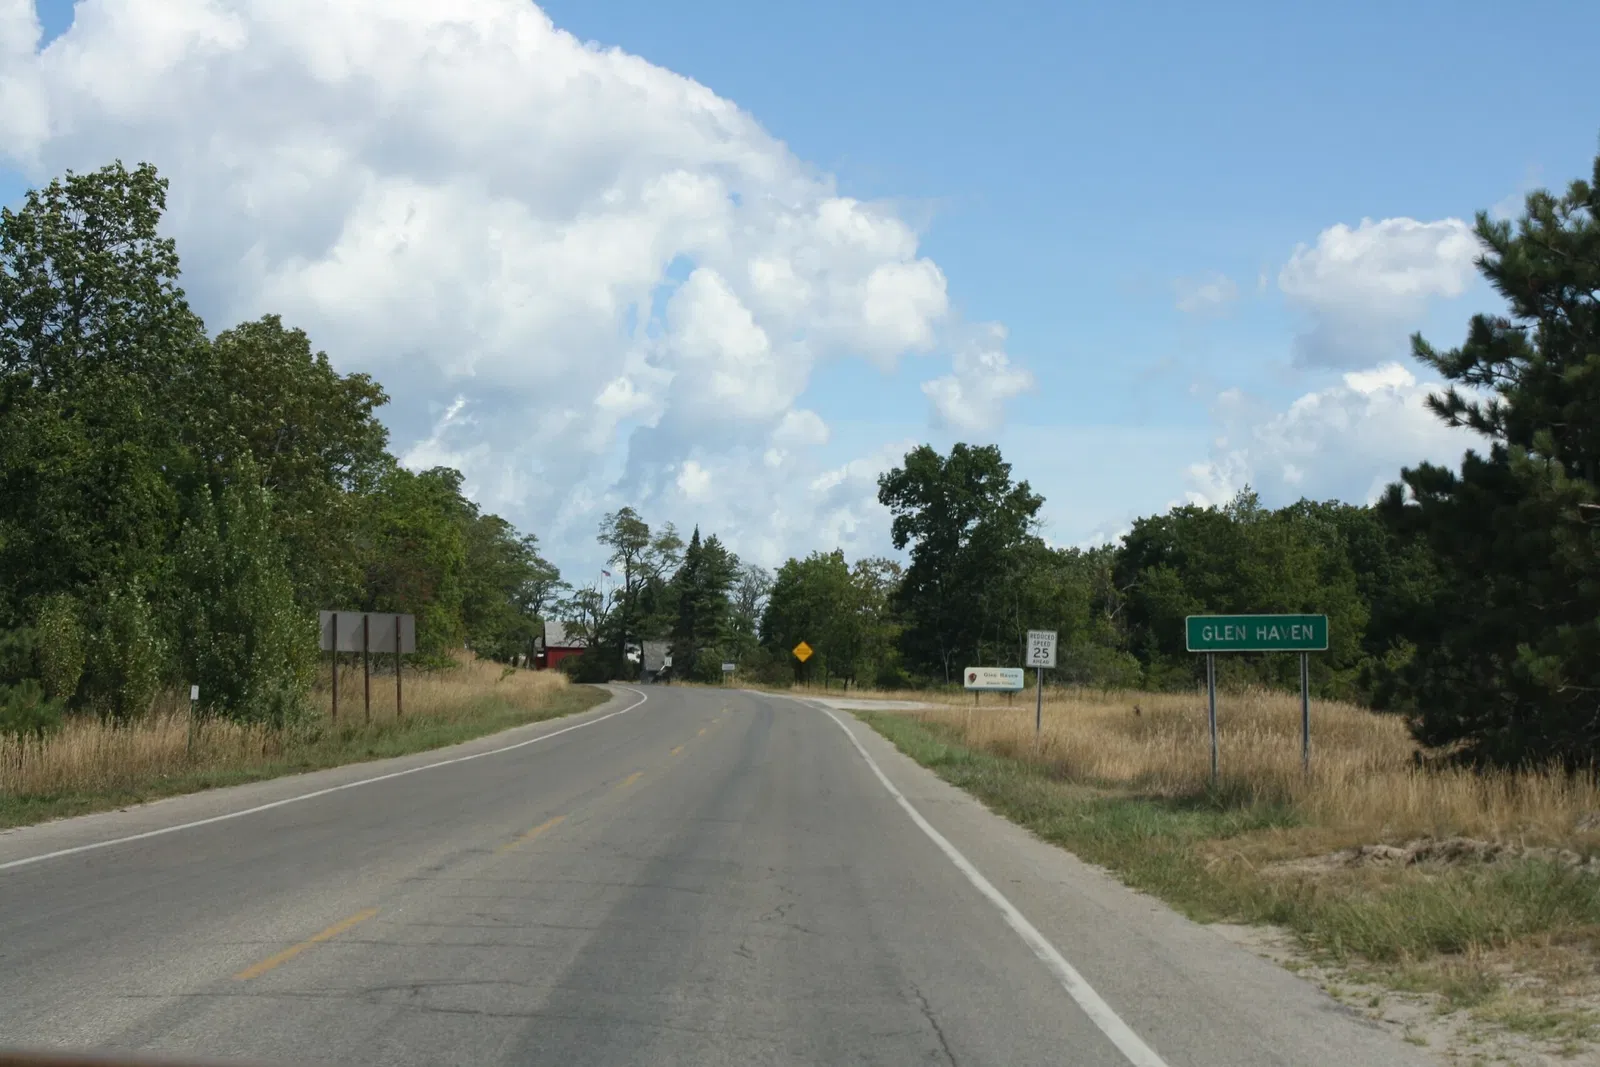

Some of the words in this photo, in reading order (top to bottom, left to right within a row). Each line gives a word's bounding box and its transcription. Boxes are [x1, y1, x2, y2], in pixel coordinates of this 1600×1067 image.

[1202, 625, 1246, 641] GLEN
[1256, 625, 1313, 640] HAVEN
[1033, 647, 1049, 658] 25
